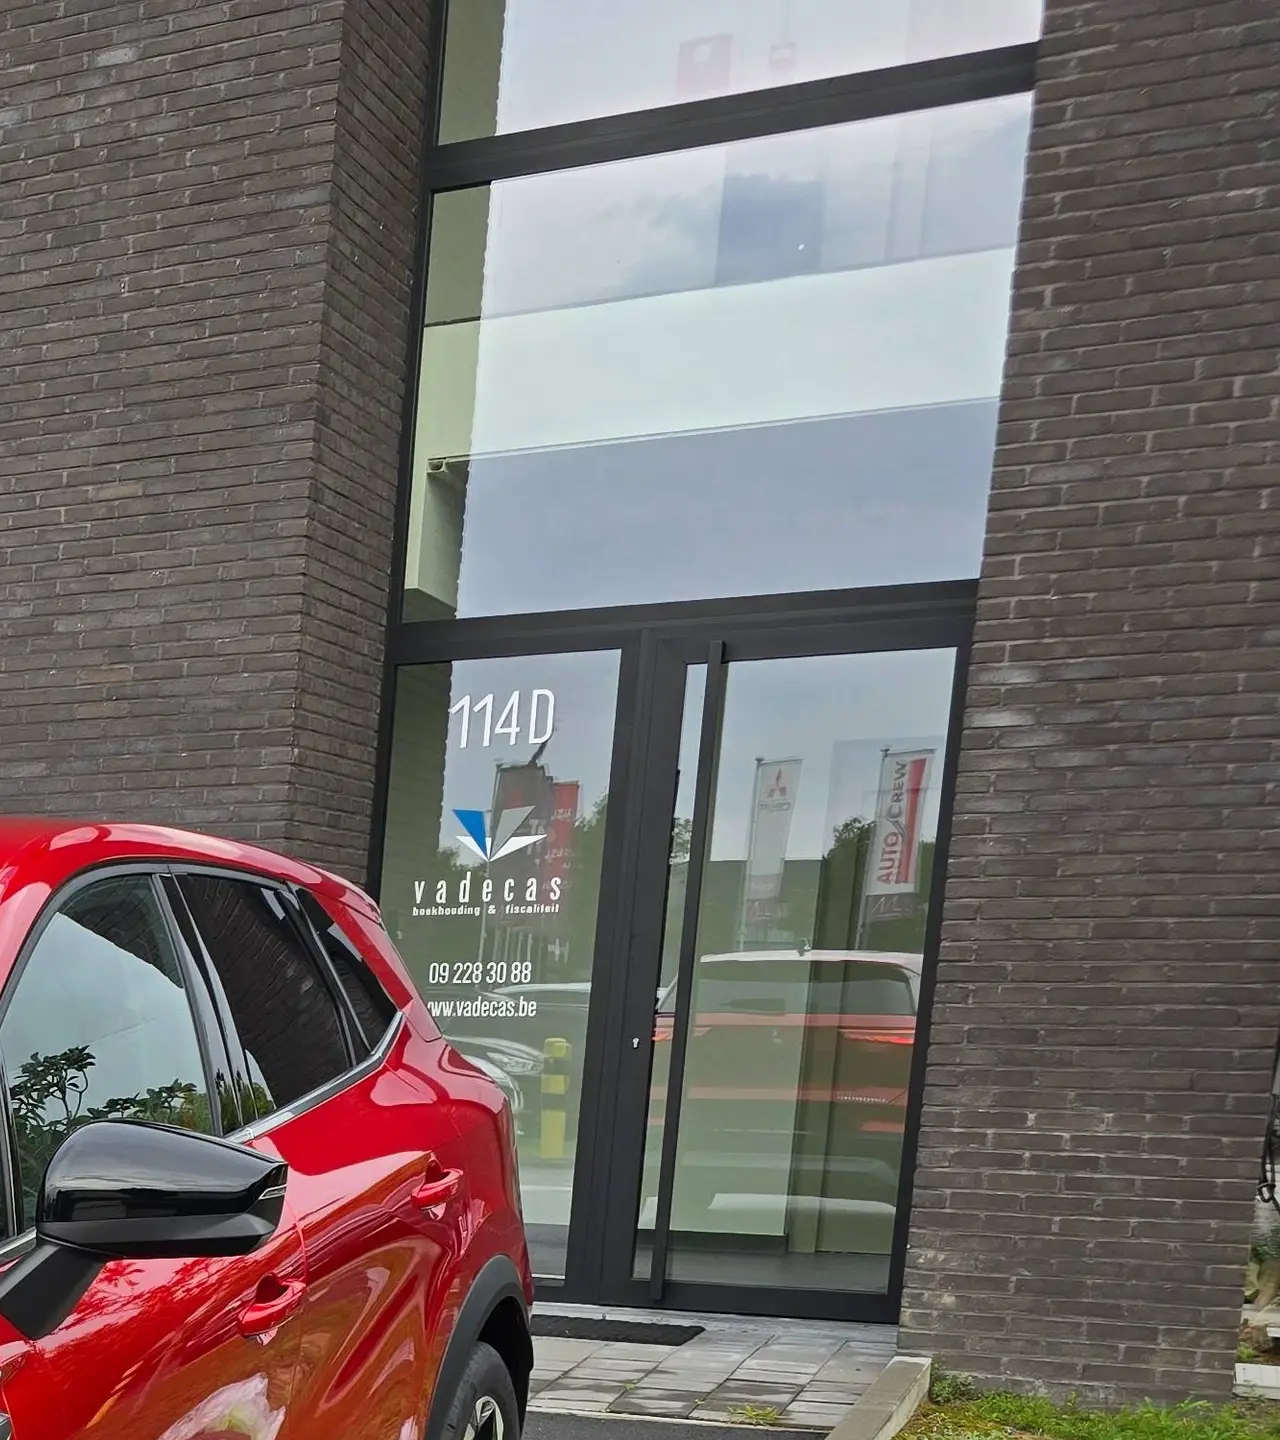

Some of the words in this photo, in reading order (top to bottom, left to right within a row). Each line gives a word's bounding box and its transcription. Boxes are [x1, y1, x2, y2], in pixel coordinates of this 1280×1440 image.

[414, 871, 562, 904] vadecas
[487, 904, 497, 915] &
[505, 903, 560, 914] fiscaliteit
[429, 962, 449, 984] 09
[452, 962, 482, 984] 228
[485, 961, 507, 984] 30
[510, 961, 532, 984] 88
